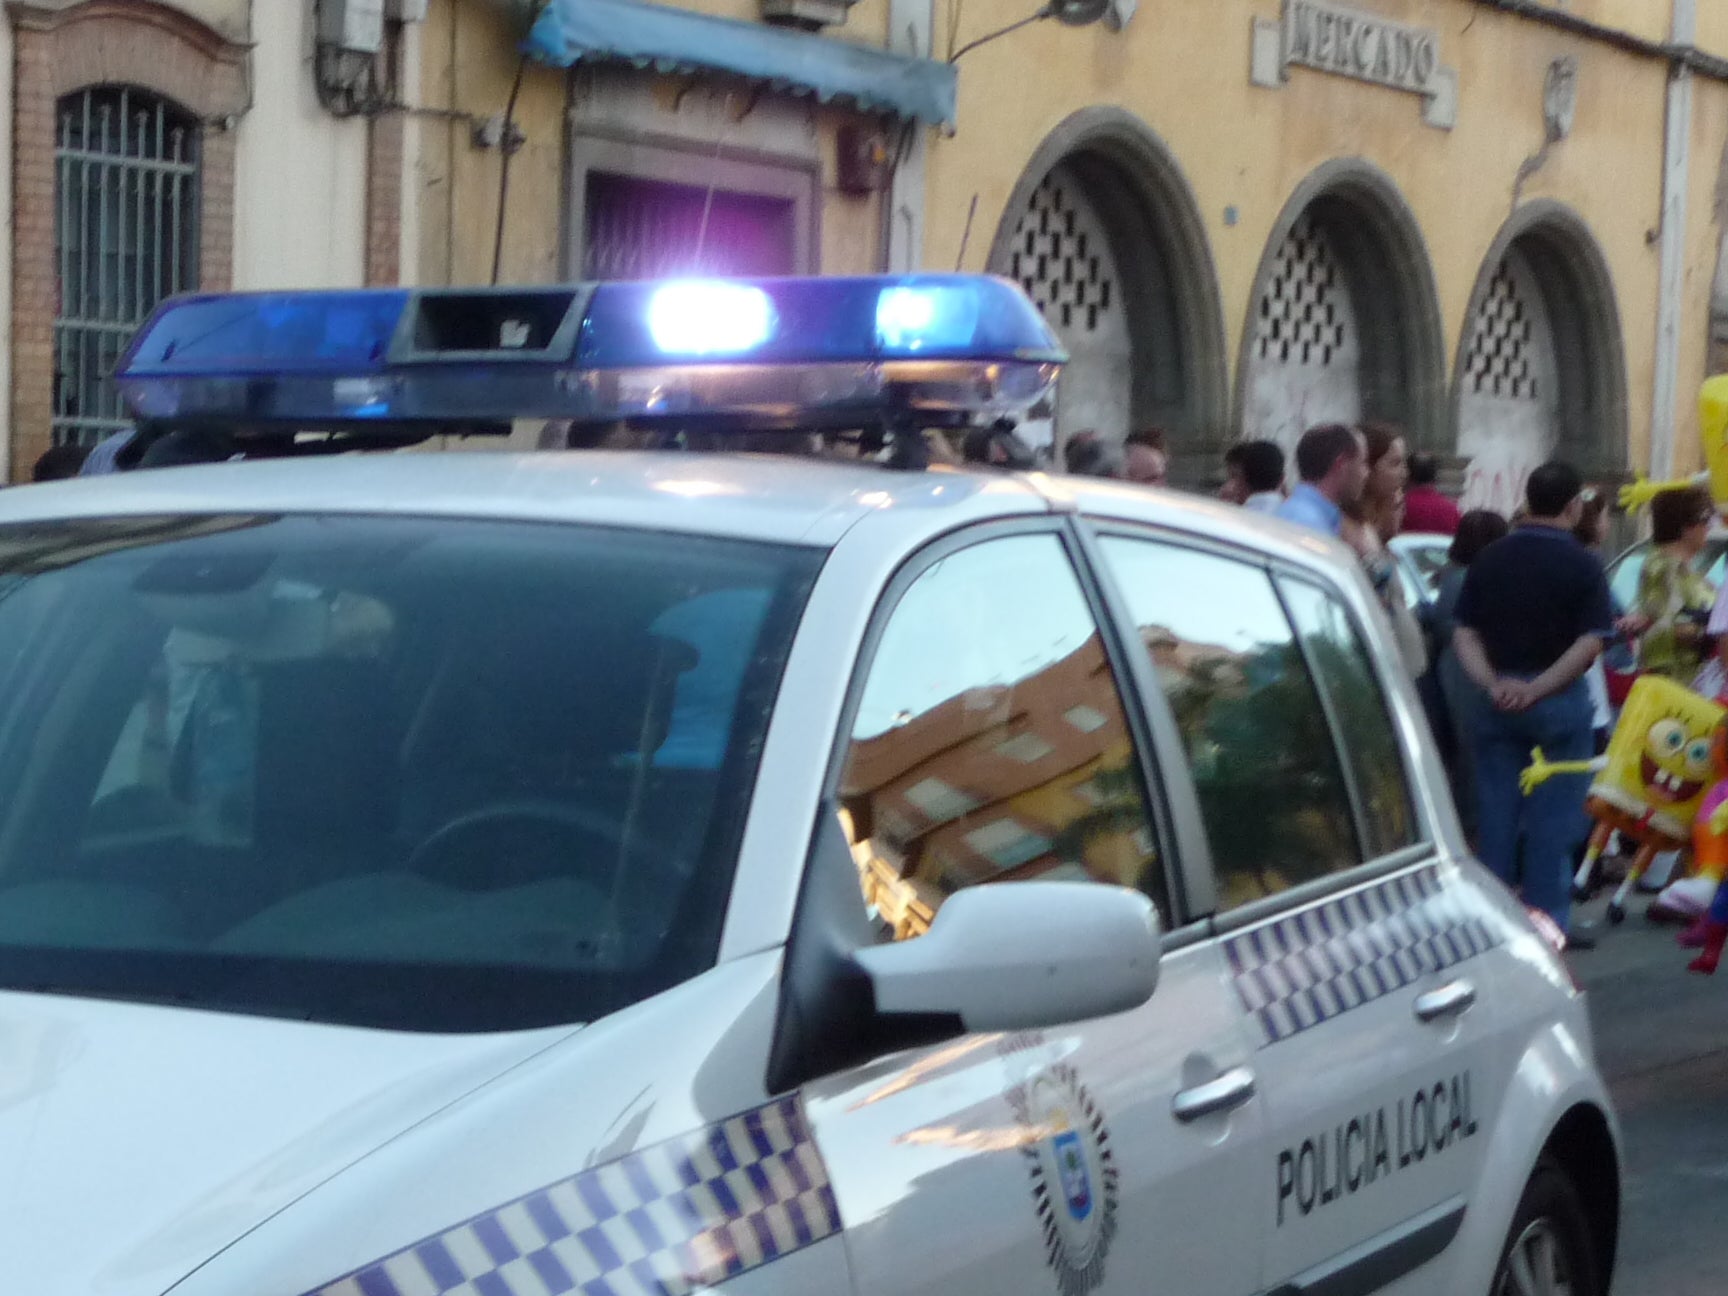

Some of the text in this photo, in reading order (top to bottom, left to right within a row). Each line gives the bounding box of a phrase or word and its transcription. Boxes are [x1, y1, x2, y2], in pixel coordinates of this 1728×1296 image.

[1290, 1, 1434, 87] MERCADO
[1276, 1069, 1479, 1228] POLICIA LOCAL
